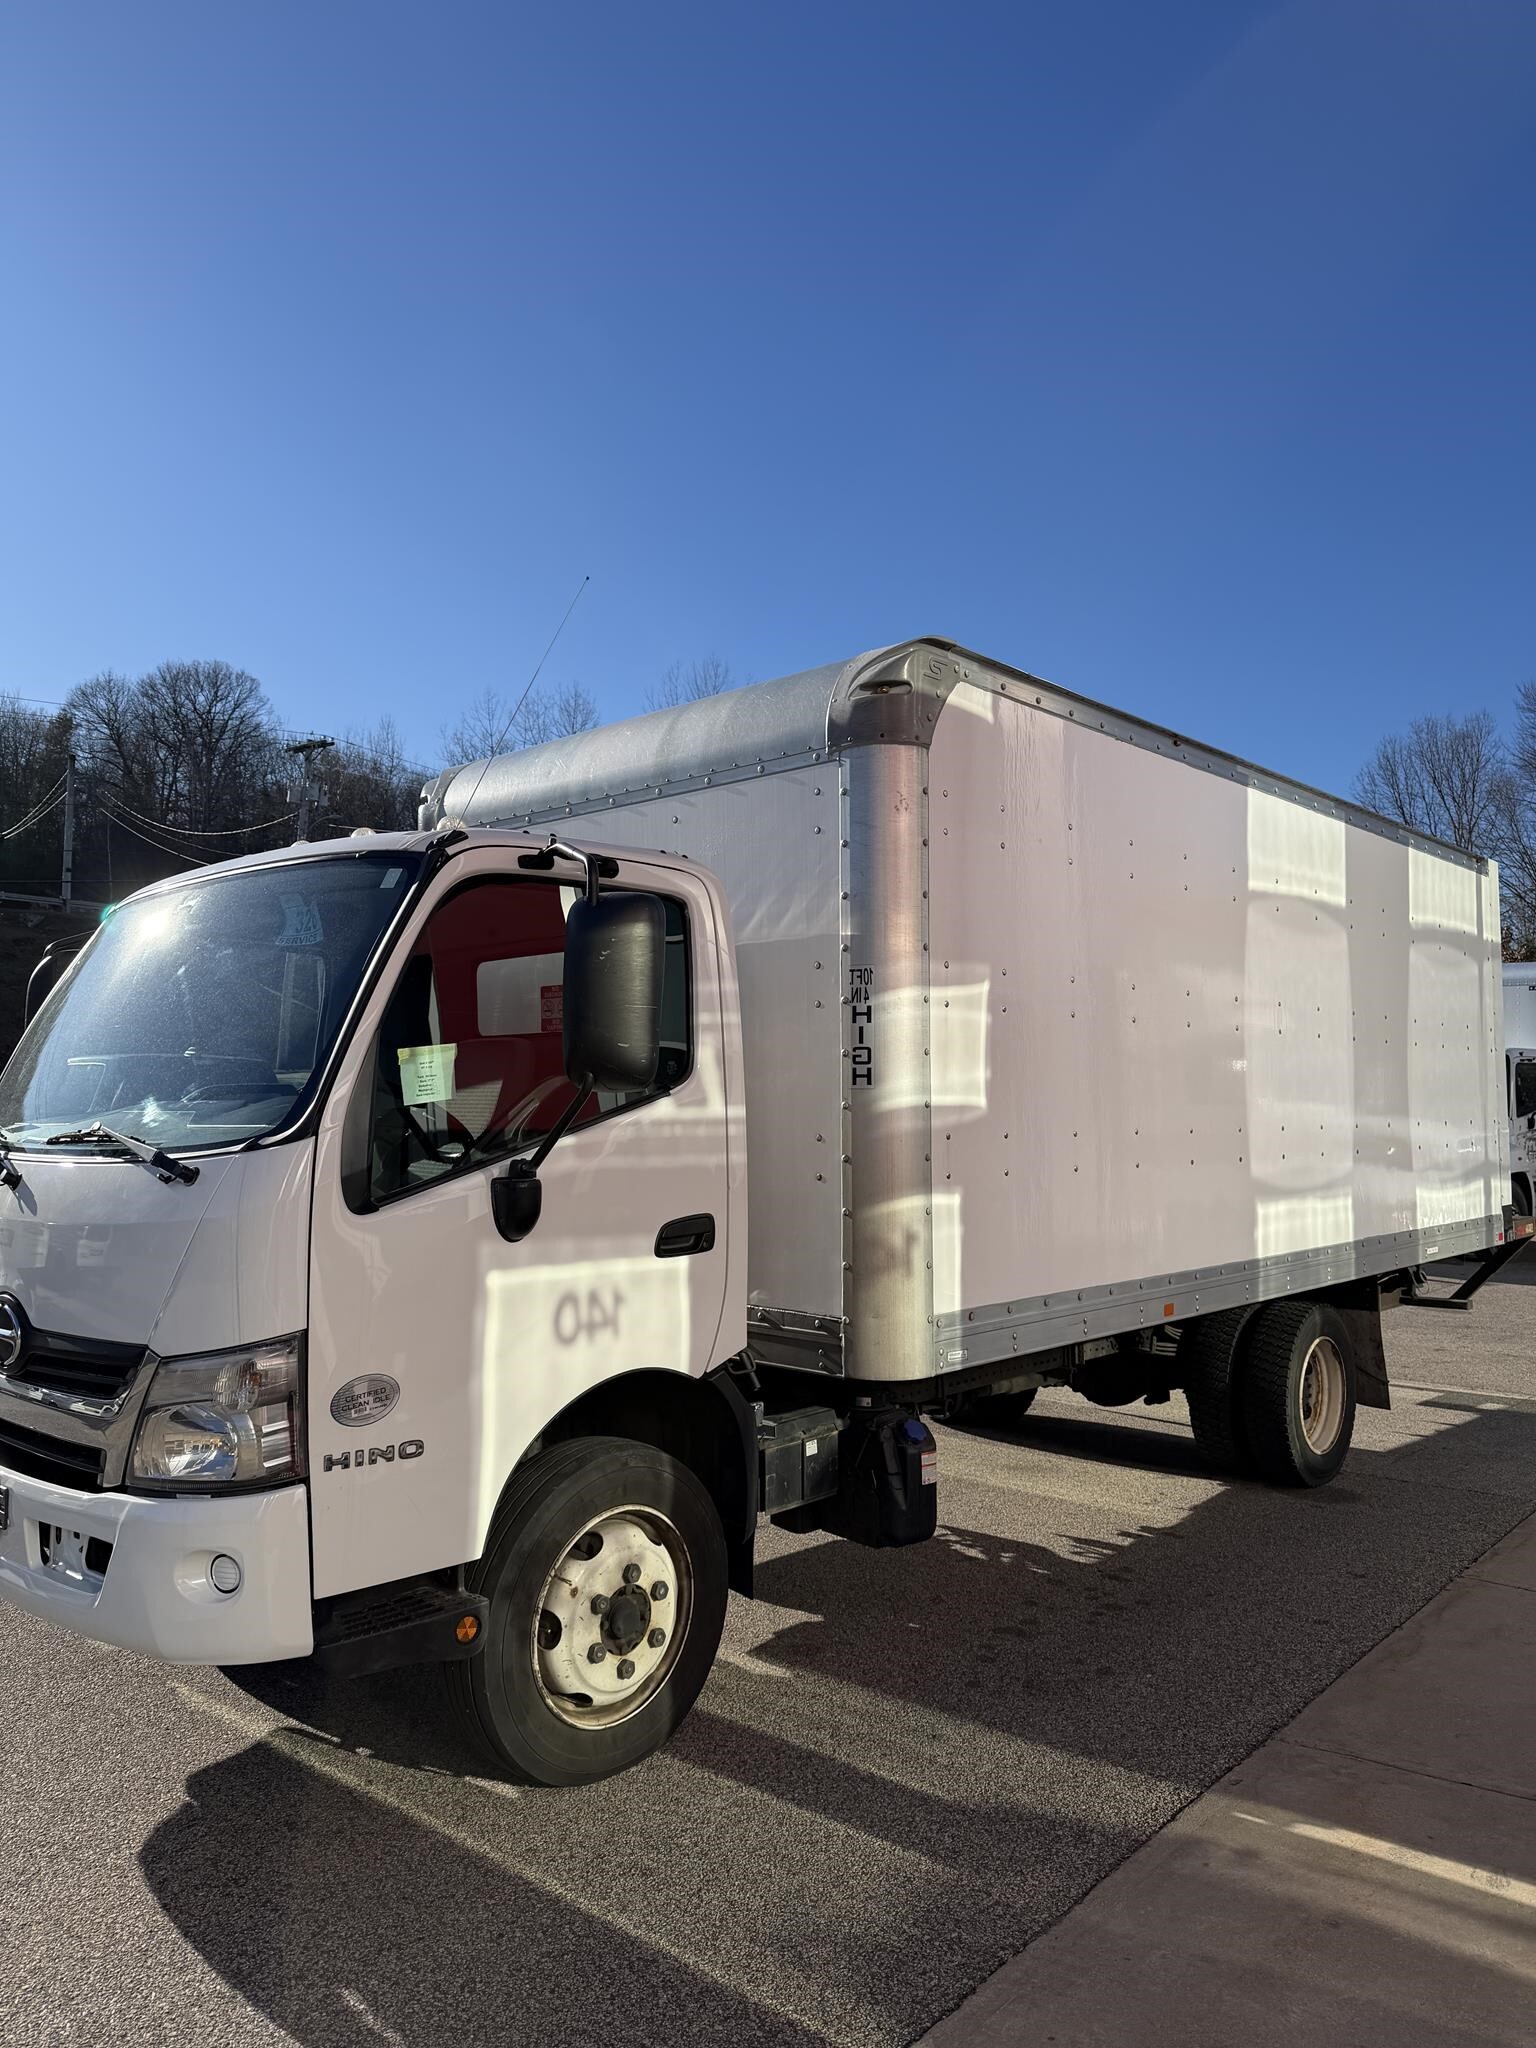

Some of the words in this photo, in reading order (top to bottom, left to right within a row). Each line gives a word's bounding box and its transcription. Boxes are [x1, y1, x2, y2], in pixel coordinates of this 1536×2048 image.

[279, 933, 318, 945] SERVICE
[341, 1400, 370, 1412] CLEAN
[372, 1394, 391, 1404] IDLE
[344, 1386, 387, 1404] CERTIFIED
[323, 1439, 424, 1472] HINO
